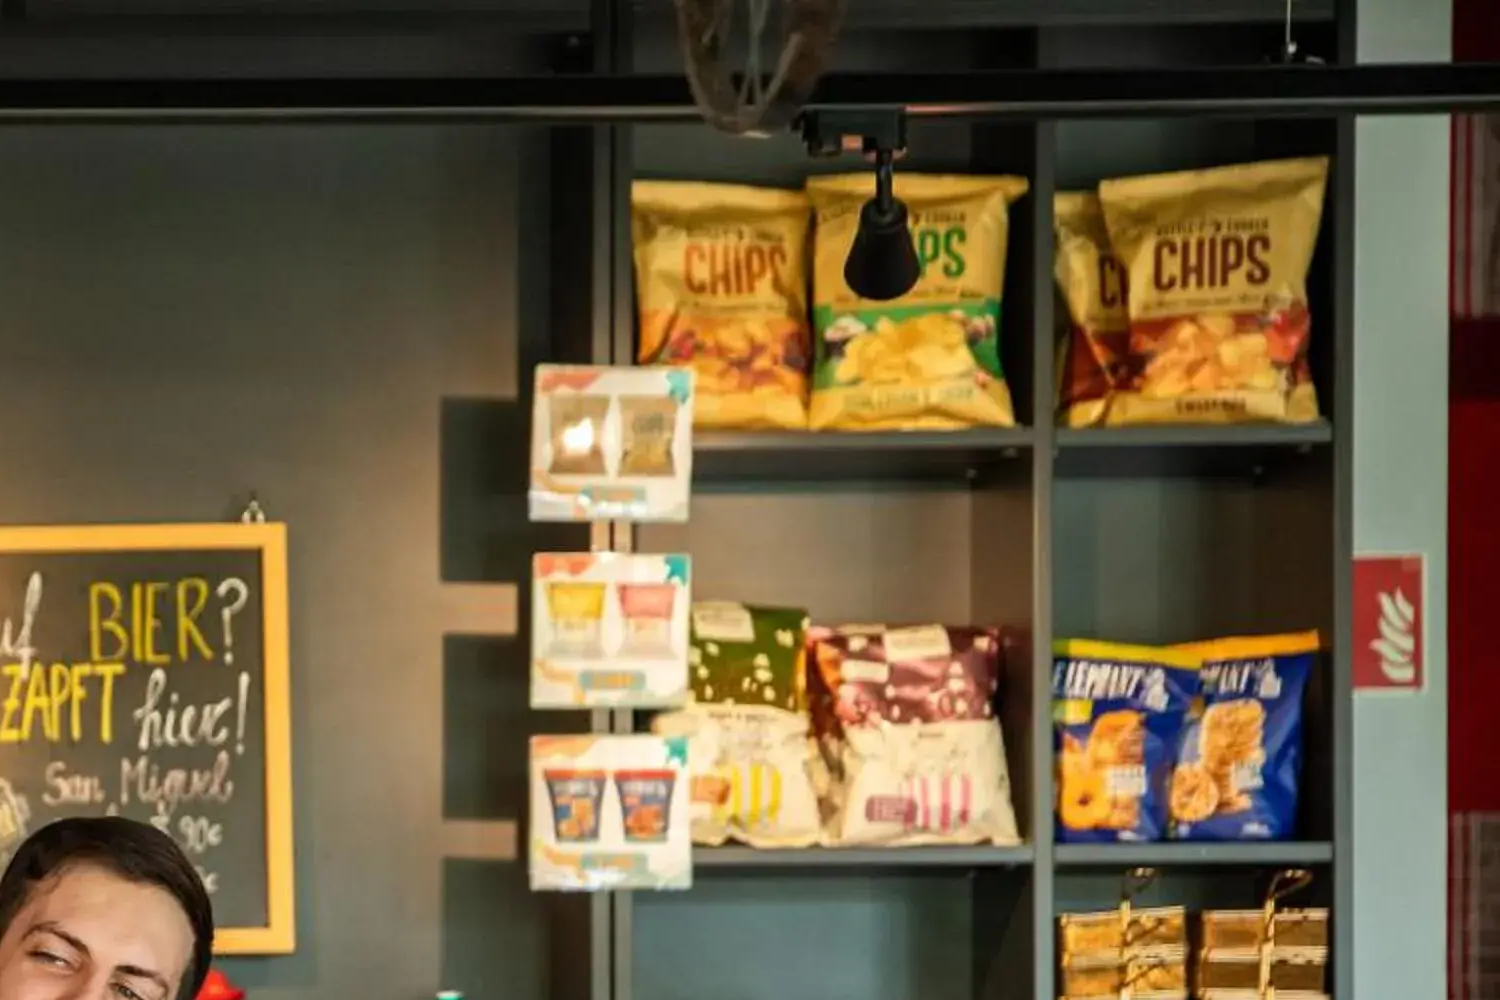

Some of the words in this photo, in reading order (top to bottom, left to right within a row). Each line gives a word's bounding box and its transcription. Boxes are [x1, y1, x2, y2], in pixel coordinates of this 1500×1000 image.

[684, 243, 788, 296] CHIPS
[1152, 235, 1271, 293] CHIPS
[89, 576, 249, 665] BIER?
[133, 668, 251, 756] hier!
[42, 761, 105, 806] San
[120, 750, 235, 814] Miguel
